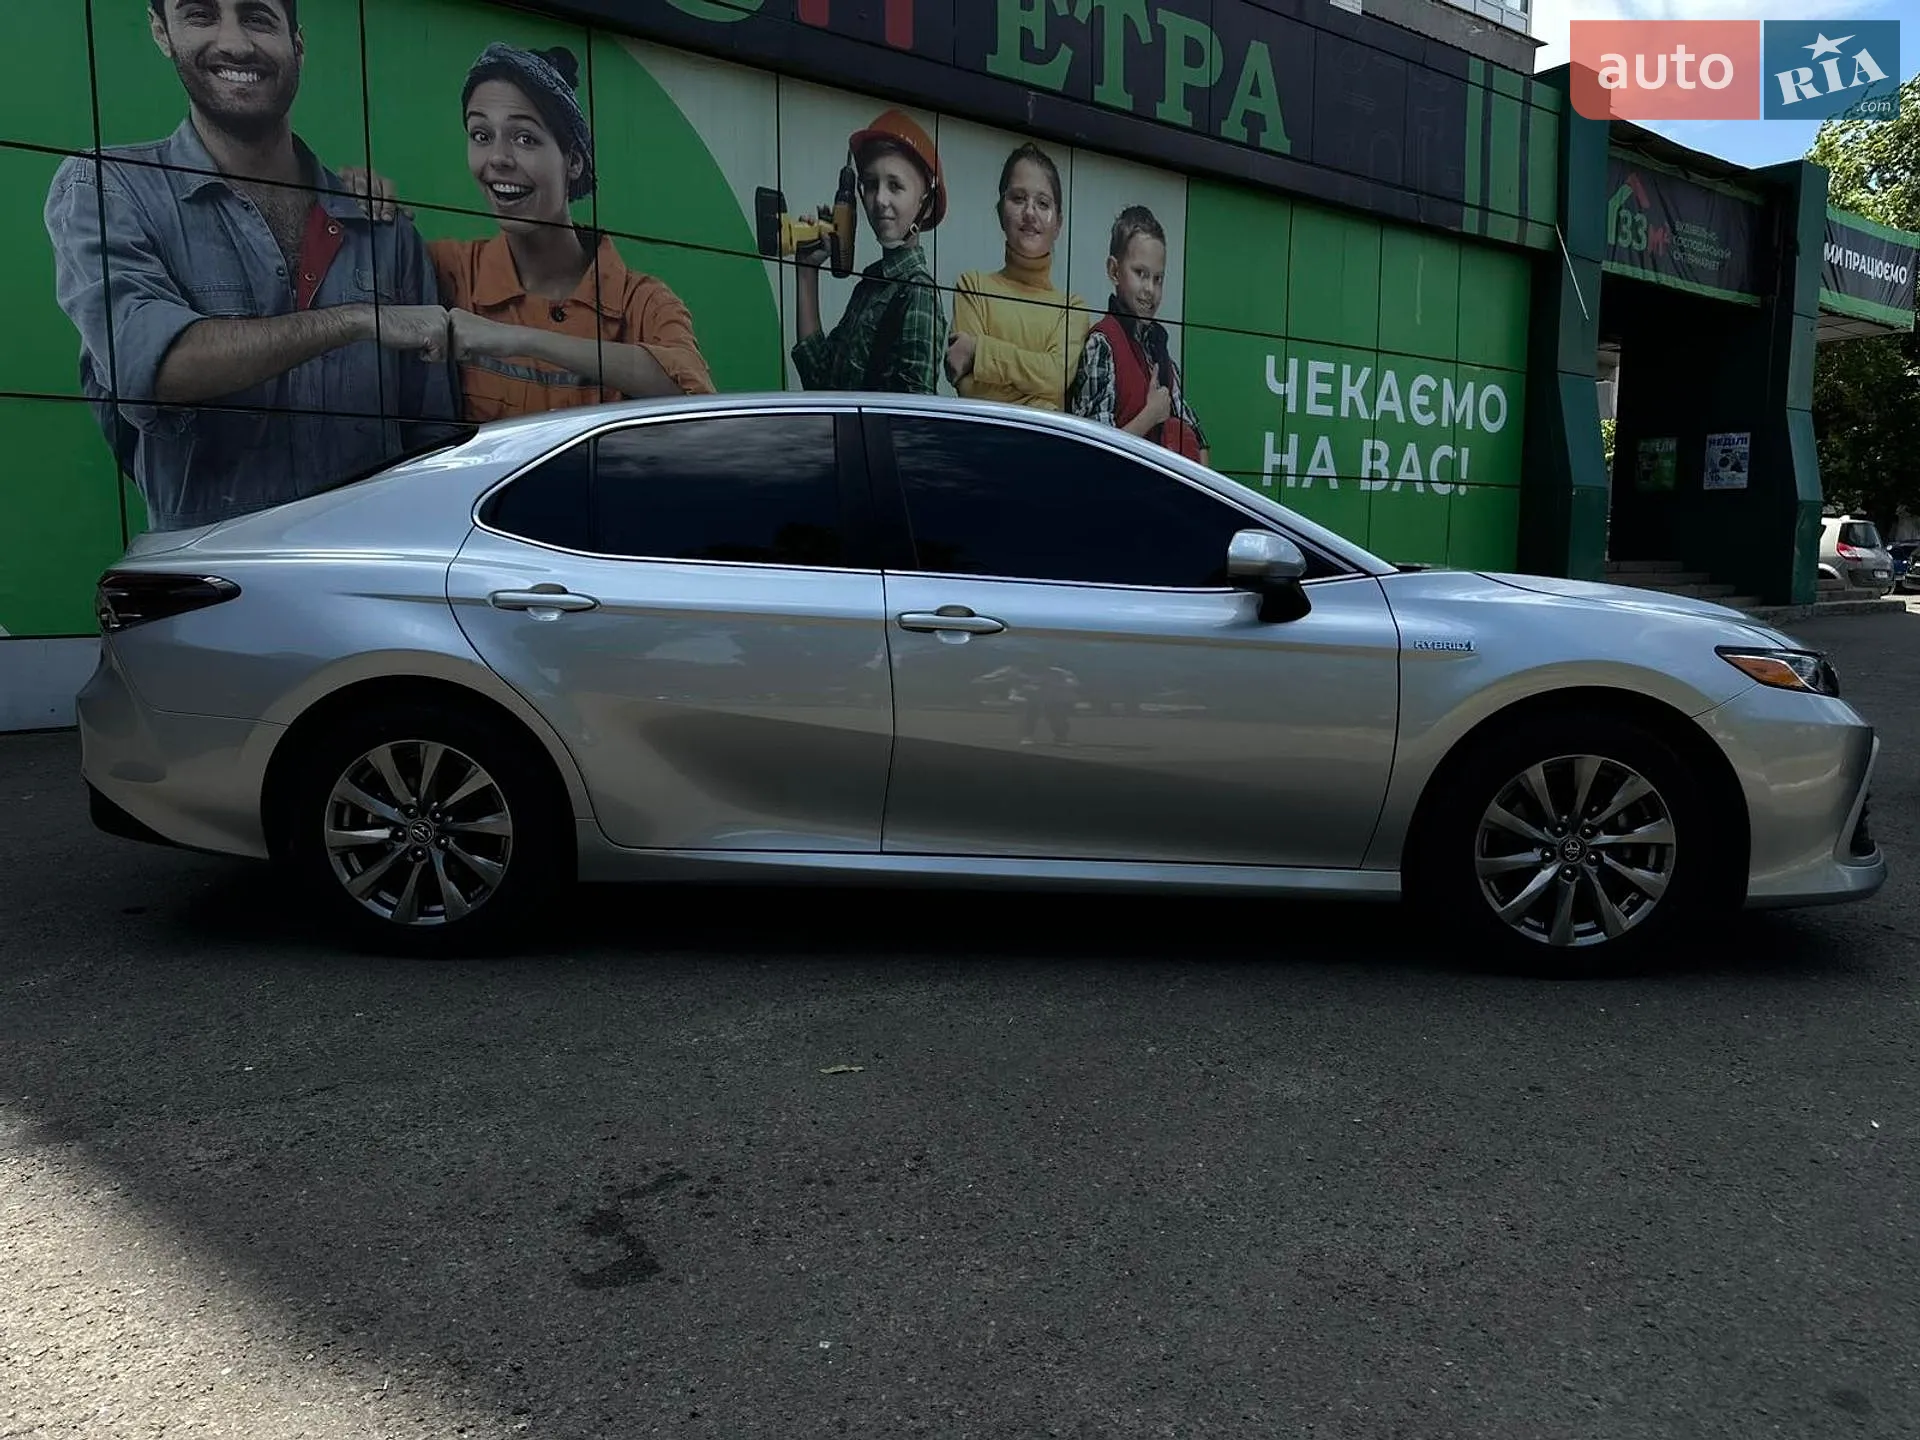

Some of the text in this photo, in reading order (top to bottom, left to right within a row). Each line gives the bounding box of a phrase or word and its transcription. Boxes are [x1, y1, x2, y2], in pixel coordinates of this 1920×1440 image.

[1845, 248, 1907, 285] ПРАЦЮЄМО
[1265, 354, 1508, 433] ЧЕКАЄМО
[1262, 431, 1469, 496] НА ВАС!
[1413, 639, 1469, 652] HYBRID
